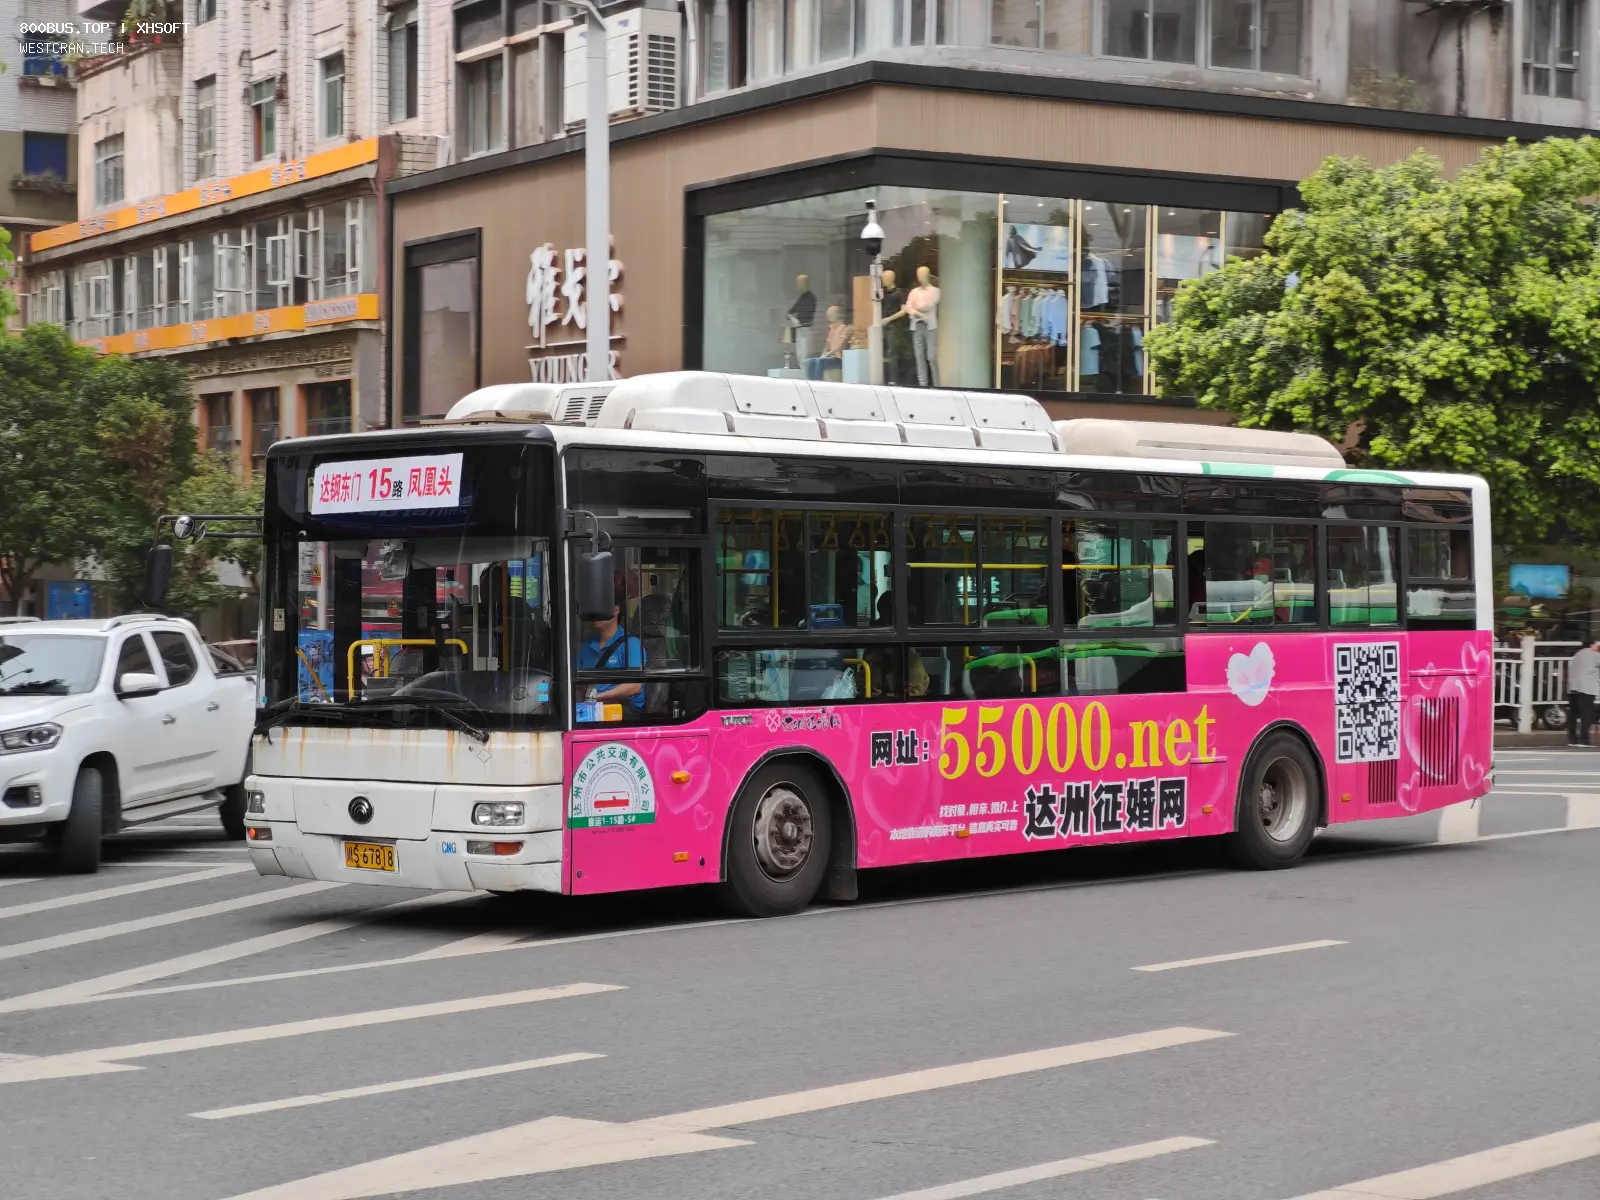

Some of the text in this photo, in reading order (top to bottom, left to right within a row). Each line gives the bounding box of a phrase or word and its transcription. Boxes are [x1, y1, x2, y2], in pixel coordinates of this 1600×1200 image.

[528, 350, 623, 383] YOUNGR
[319, 471, 362, 503] 达钢东门
[407, 465, 453, 498] 凤凰头
[938, 701, 1217, 780] 55000.net
[1023, 776, 1188, 842] 达州征婚网
